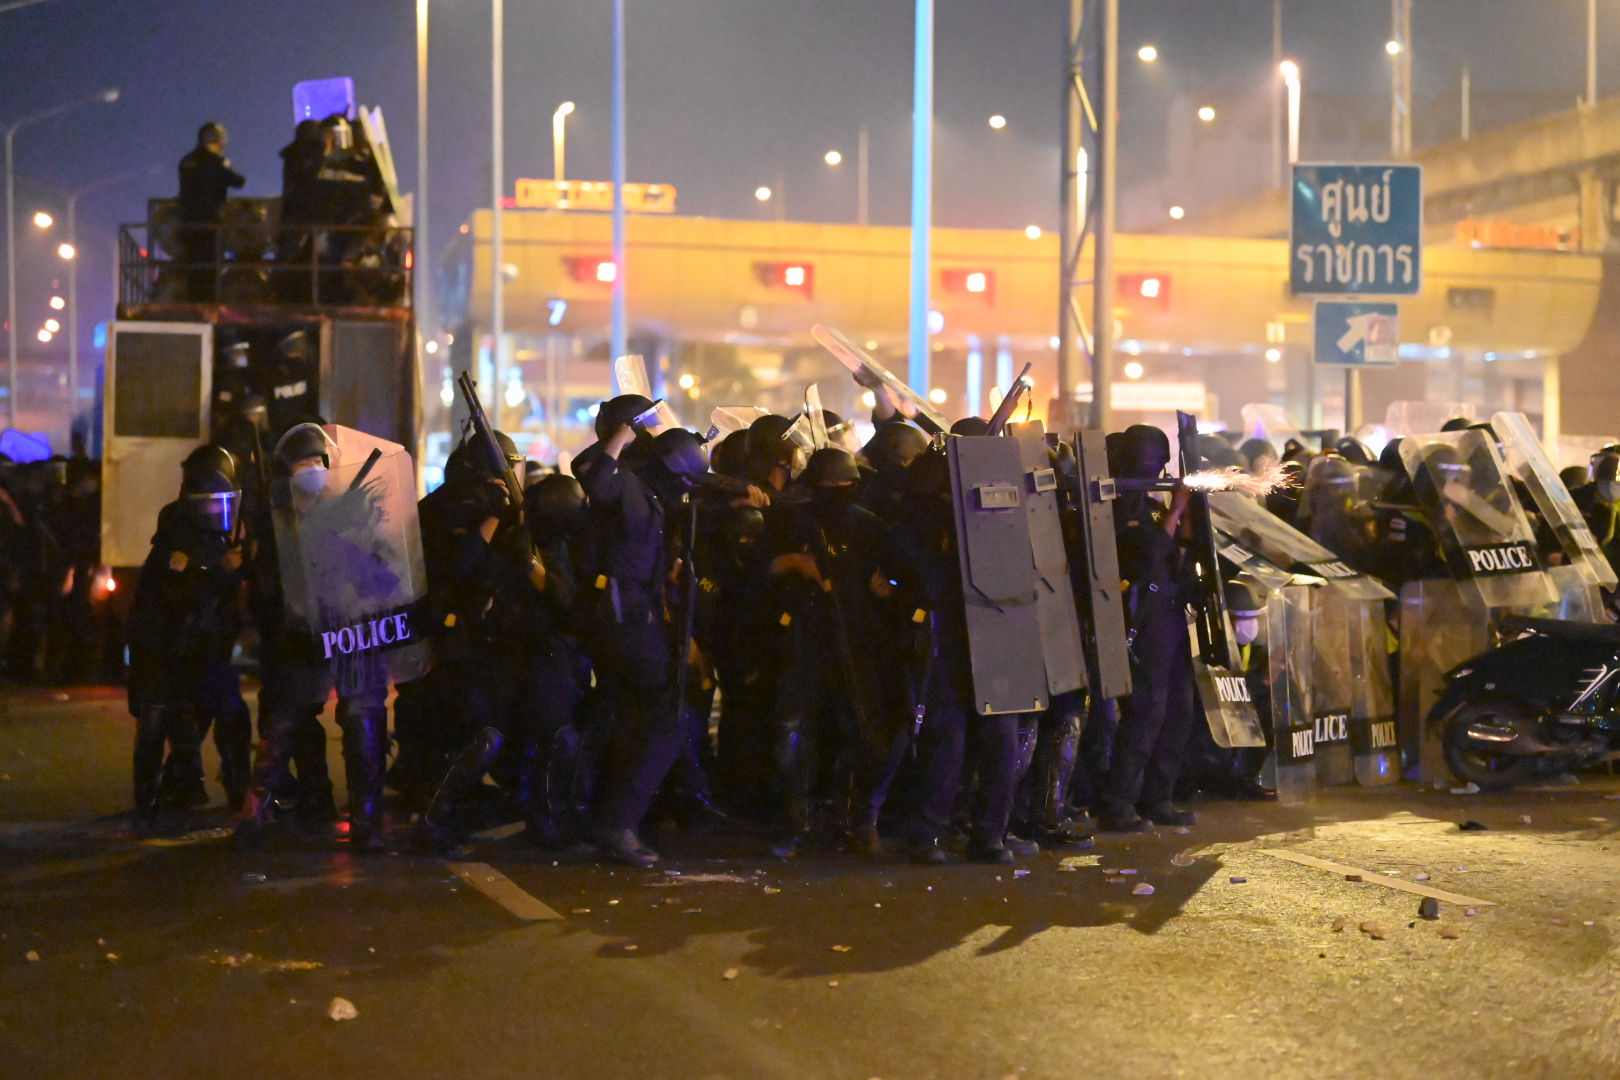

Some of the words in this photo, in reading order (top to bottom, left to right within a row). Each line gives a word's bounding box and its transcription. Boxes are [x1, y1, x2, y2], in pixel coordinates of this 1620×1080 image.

[1321, 169, 1393, 238] ศูนย์
[1297, 241, 1413, 284] ราชการ
[1468, 546, 1532, 572] POLICE
[321, 612, 411, 659] POLICE
[1214, 676, 1251, 702] POLICE
[1314, 714, 1348, 743] LICE
[1291, 729, 1314, 758] POLICE
